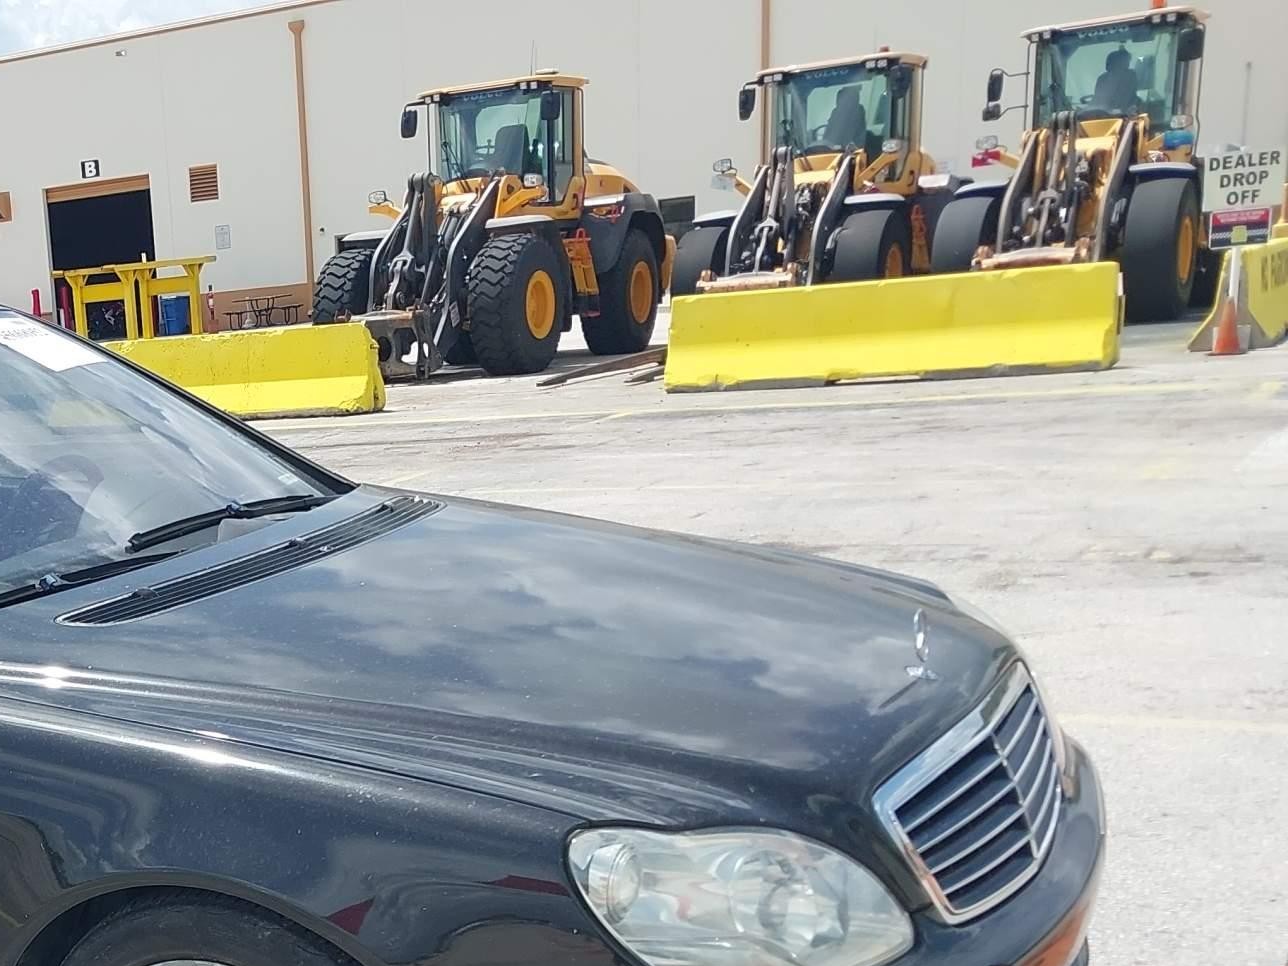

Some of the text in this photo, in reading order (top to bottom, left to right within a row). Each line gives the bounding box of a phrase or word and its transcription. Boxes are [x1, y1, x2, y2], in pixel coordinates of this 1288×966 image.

[1208, 150, 1281, 171] DEALER
[84, 161, 97, 178] B
[1219, 170, 1269, 188] DROP
[1226, 189, 1261, 205] OFF
